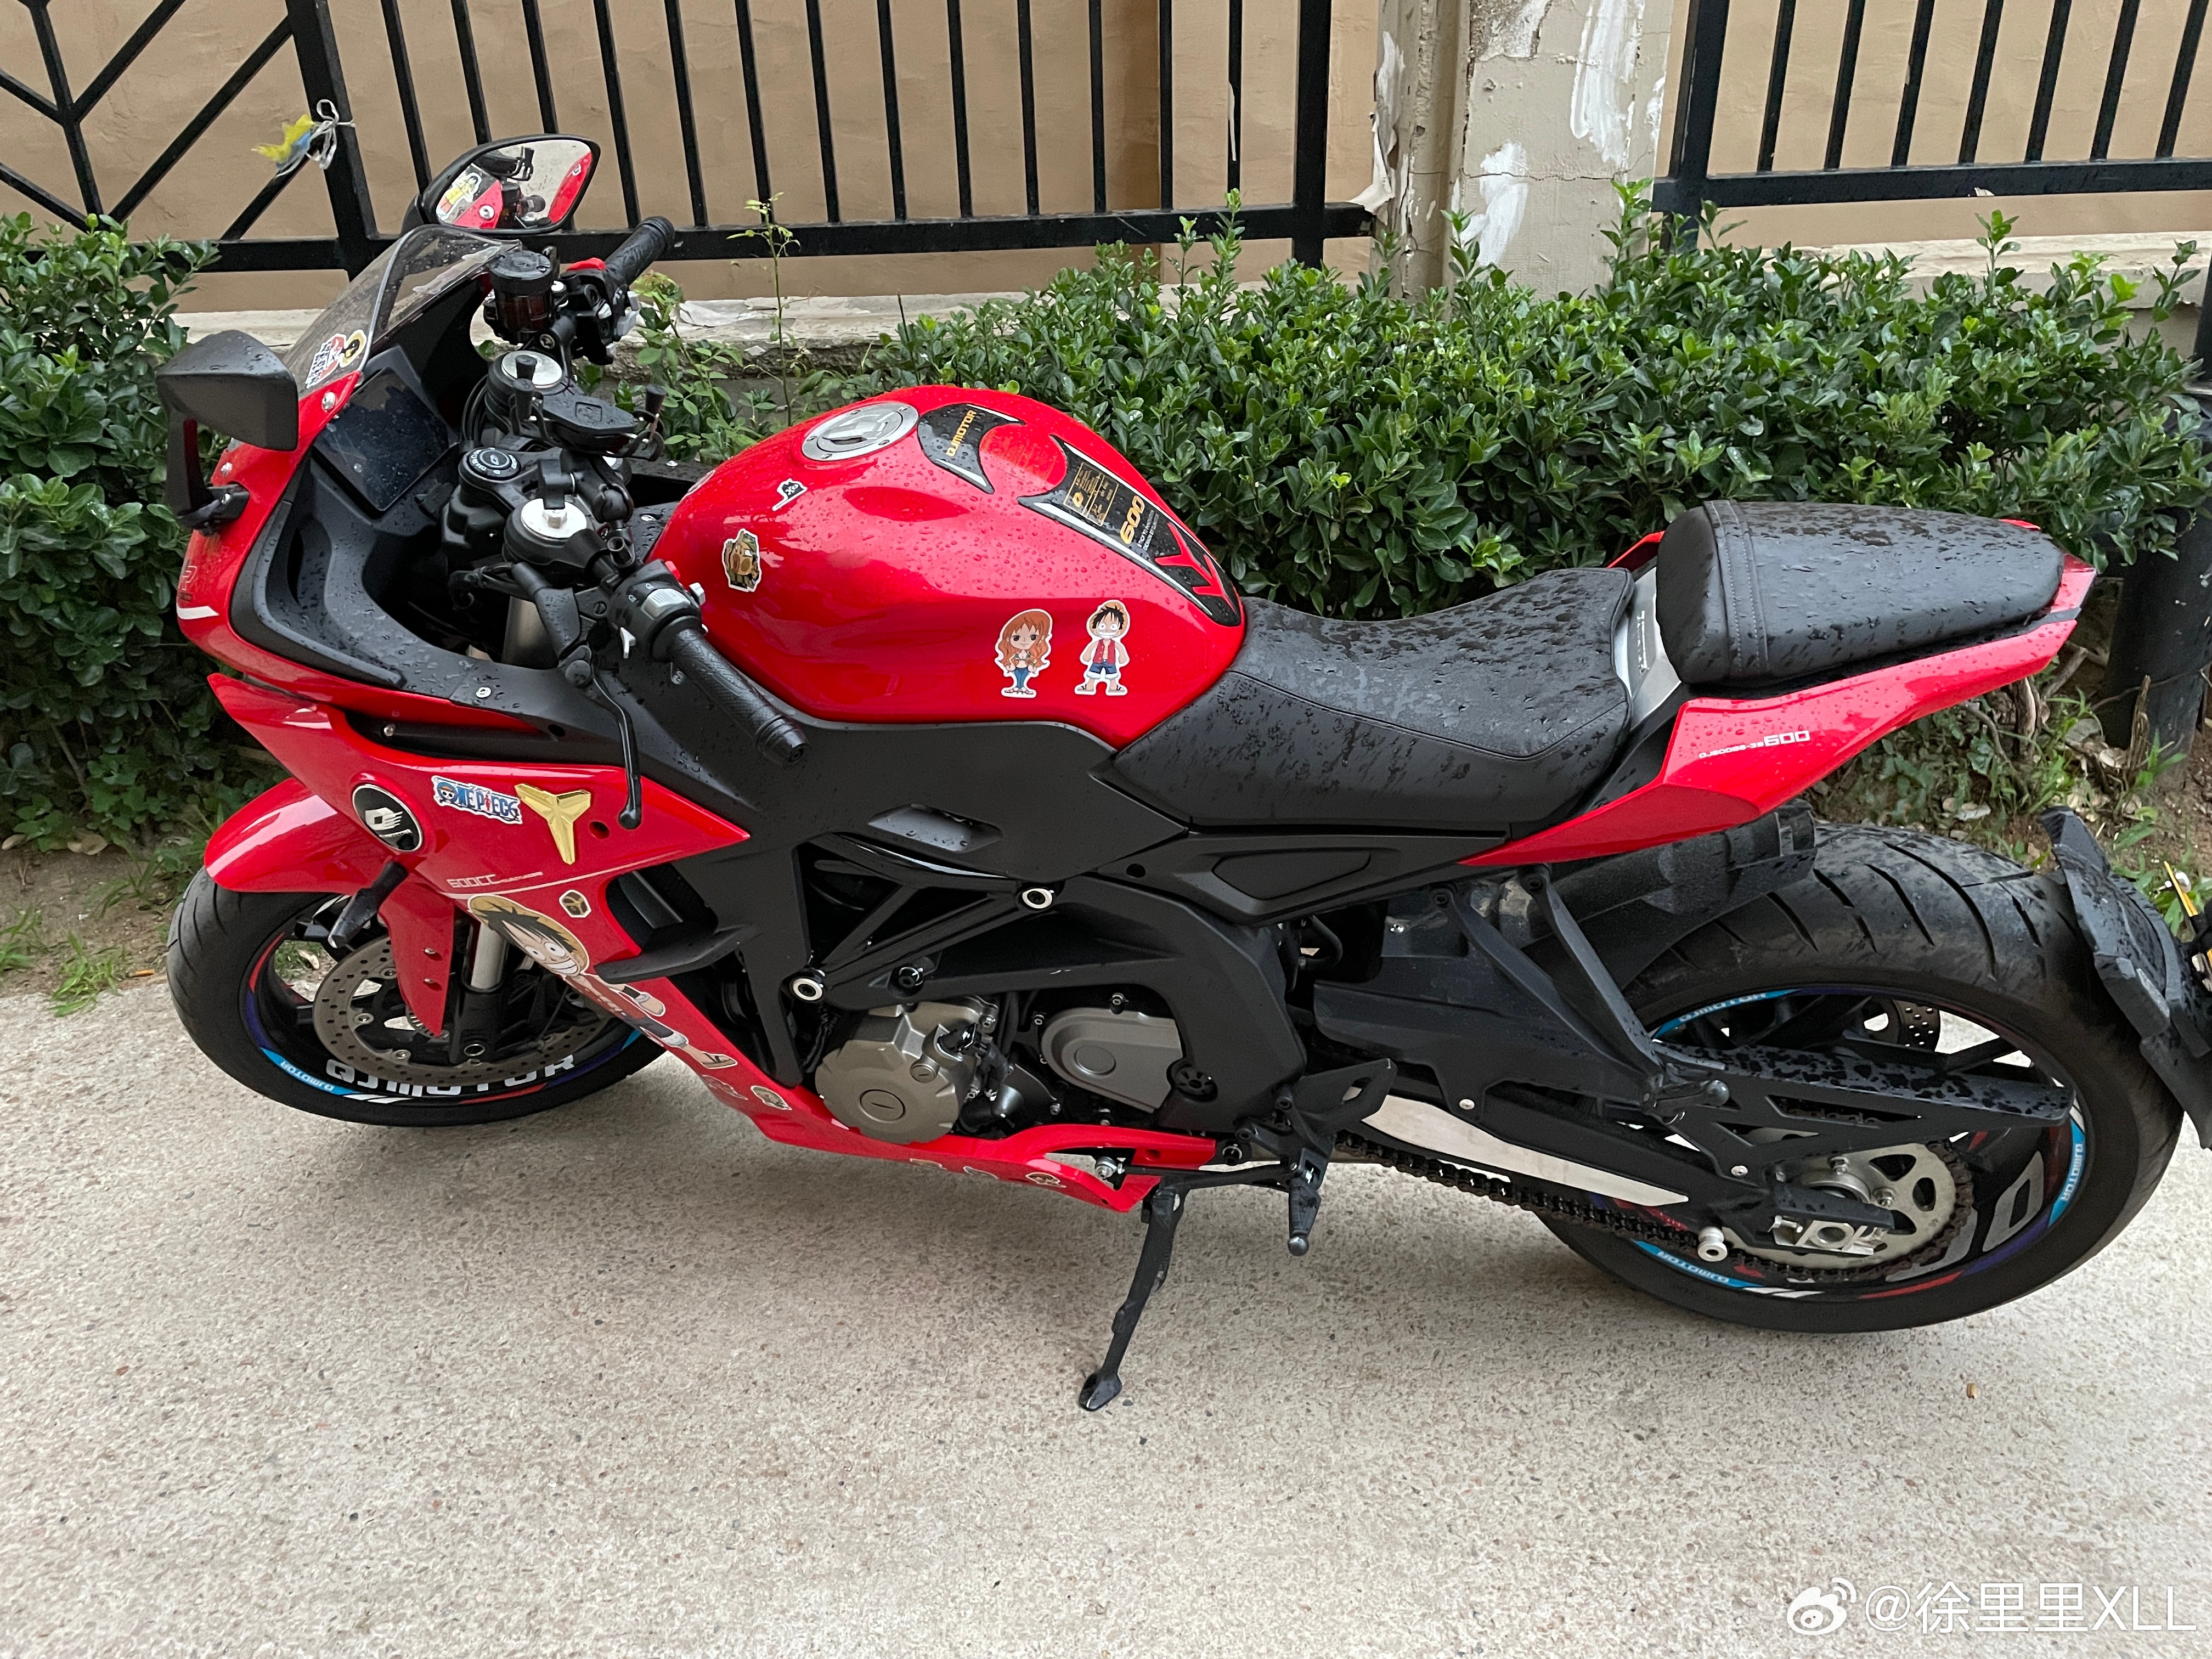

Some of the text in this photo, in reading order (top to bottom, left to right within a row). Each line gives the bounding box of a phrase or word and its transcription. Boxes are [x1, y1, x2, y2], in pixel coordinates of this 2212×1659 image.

[946, 410, 977, 456] QJMOTOR
[1120, 495, 1145, 544] 600
[1764, 730, 1810, 747] 600
[437, 782, 519, 819] ONE PIECE
[446, 874, 501, 888] 600CC
[1679, 991, 1767, 1022] QJMOTOR
[280, 1059, 335, 1092] QJMOTOR
[2061, 1144, 2084, 1201] QJMOTOR
[1657, 1250, 1731, 1283] QJMOTOR
